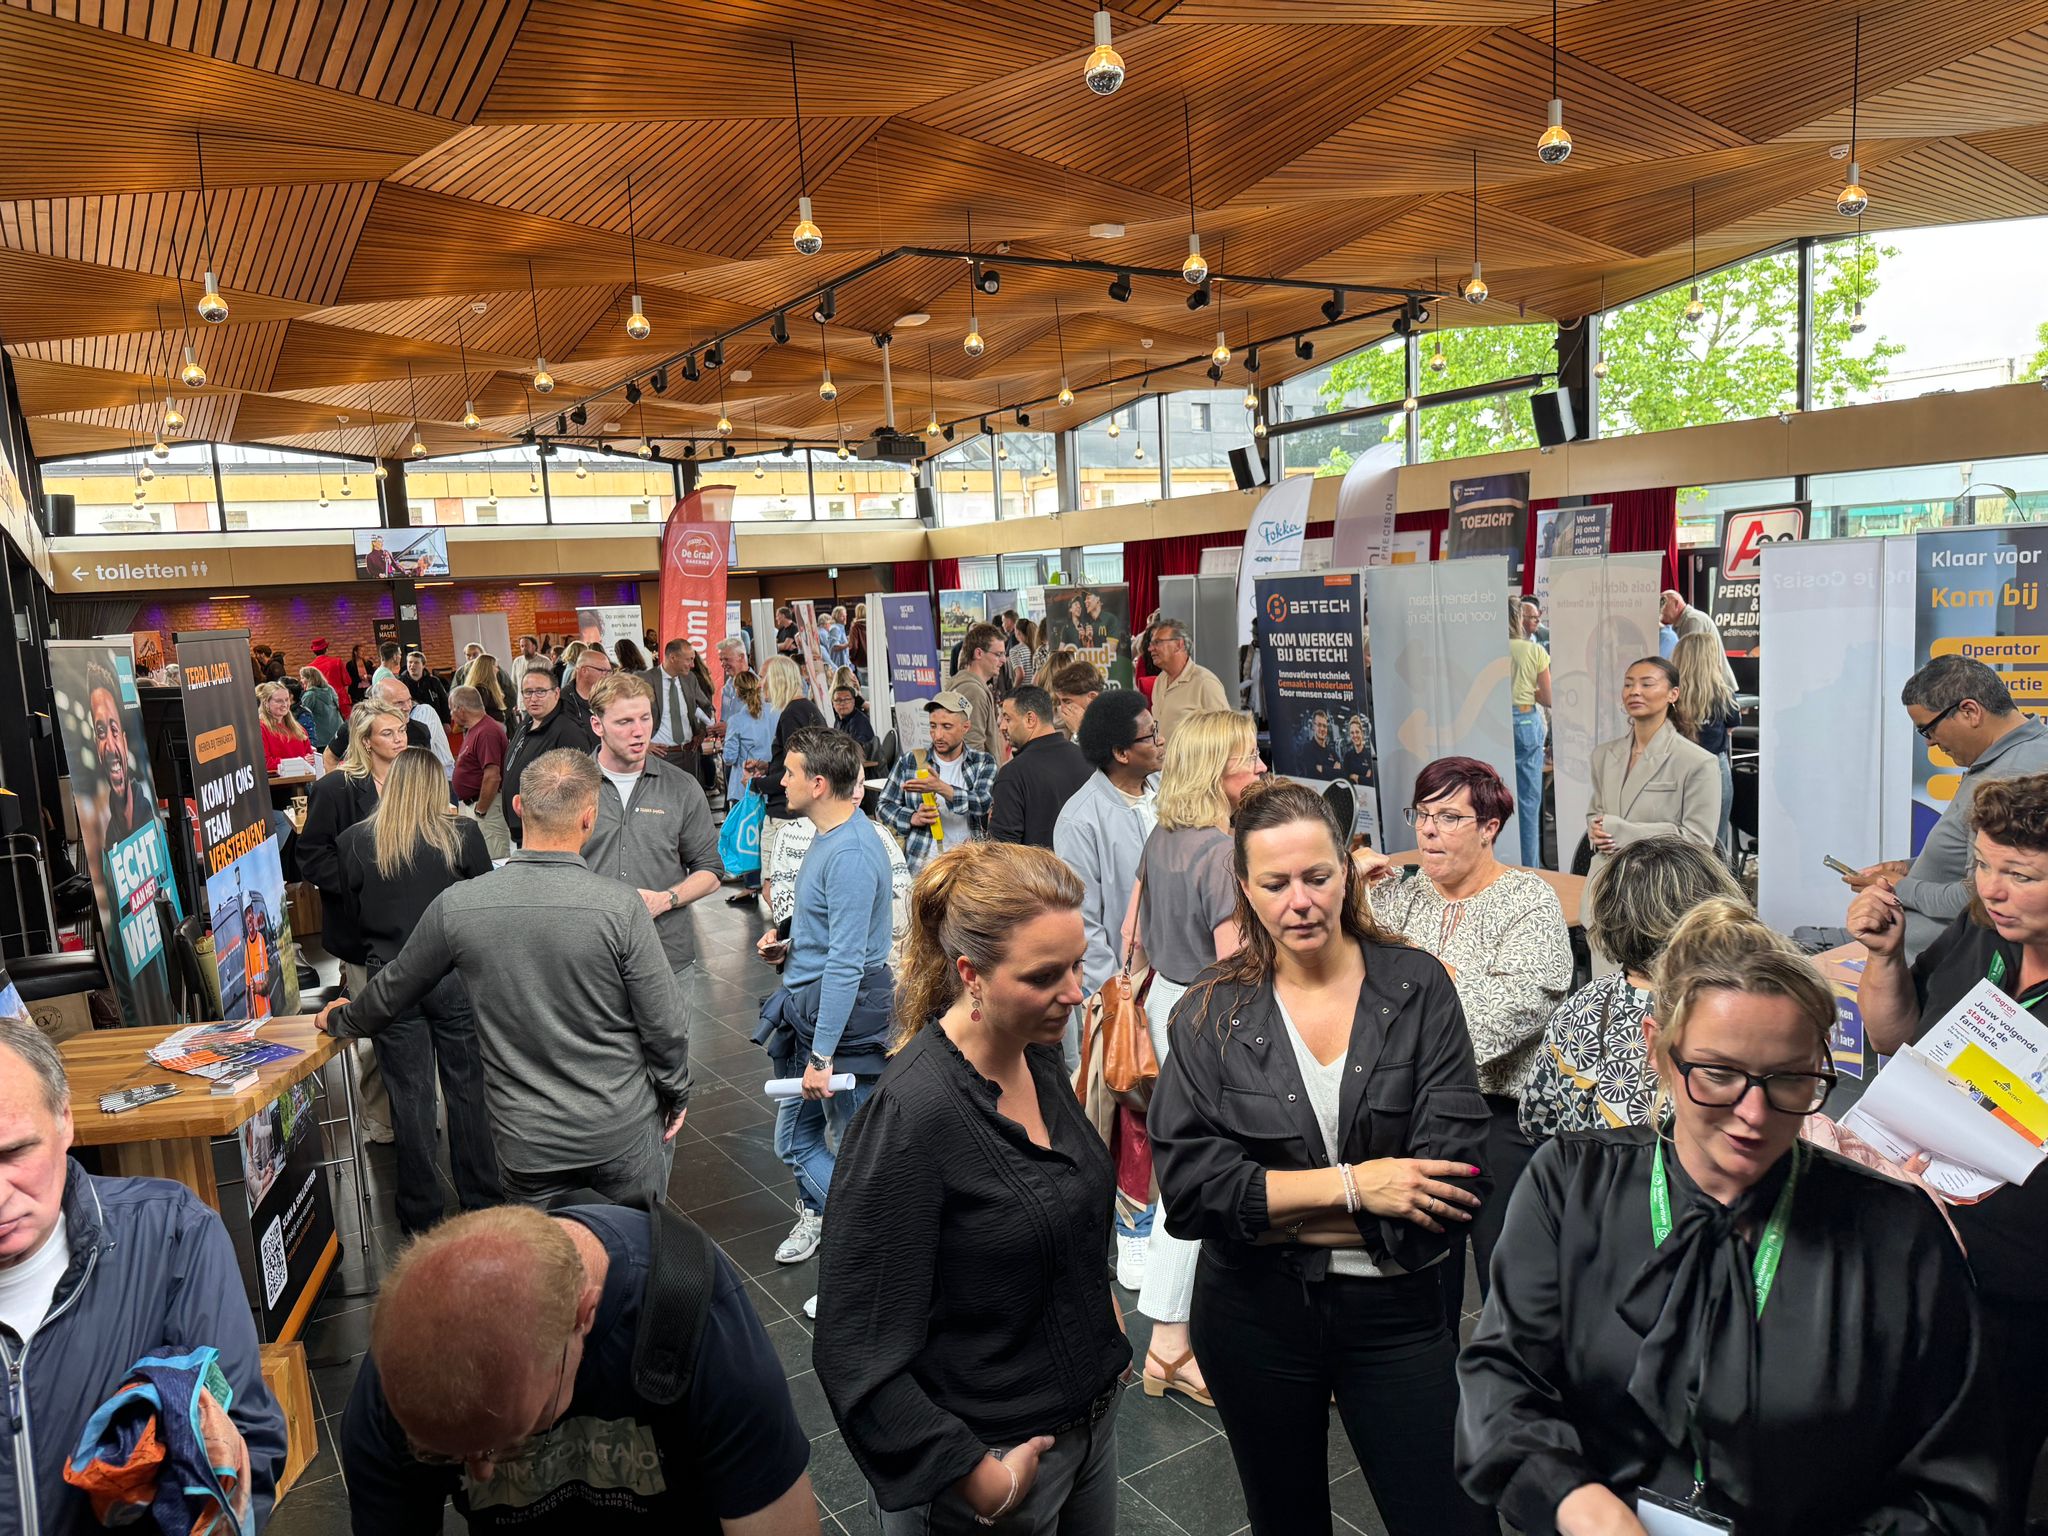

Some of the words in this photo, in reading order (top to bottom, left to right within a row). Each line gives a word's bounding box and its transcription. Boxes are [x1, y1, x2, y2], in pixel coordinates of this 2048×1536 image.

[1381, 493, 1394, 560] PRECISION
[1460, 513, 1514, 529] TOEZICHT
[1576, 514, 1596, 524] Word
[1258, 520, 1302, 546] Fokker
[1575, 525, 1583, 536] jij
[1583, 526, 1600, 534] onze
[1574, 535, 1600, 544] nieuwe
[681, 549, 692, 559] De
[694, 549, 713, 560] Graaf
[1574, 545, 1602, 556] collega?
[1932, 551, 1988, 568] Klaar
[1993, 550, 2042, 565] voor
[95, 563, 187, 581] toiletten
[1932, 587, 1994, 608] Kom
[2003, 582, 2038, 610] bij
[1290, 600, 1350, 613] BETECH
[1751, 598, 1759, 611] &
[1269, 633, 1297, 647] KOM
[1298, 632, 1353, 647] WERKEN
[1277, 648, 1293, 662] BIJ
[1295, 648, 1348, 662] BETECH!
[1962, 643, 2041, 658] Operator
[896, 654, 910, 667] VIND
[911, 654, 928, 667] JOUW
[894, 669, 916, 682] NIEUWE
[916, 669, 936, 683] BAAN!
[1278, 670, 1318, 679] Innovatieve
[1319, 671, 1351, 680] techniek
[1278, 680, 1307, 689] Gemaakt
[1308, 680, 1315, 689] in
[1315, 681, 1354, 690] Nederland
[1279, 688, 1295, 697] Door
[1296, 690, 1322, 698] mensen
[1323, 689, 1343, 699] zoals
[201, 778, 225, 812] KOM
[235, 764, 254, 796] ONS
[205, 809, 232, 846] TEAM
[209, 818, 266, 874] VERSTERKEN?
[111, 828, 159, 899] ÉCHT
[131, 888, 145, 912] AAN
[1991, 993, 2017, 1015] Fagron
[1959, 1015, 1998, 1050] farmacie.
[1966, 1008, 1986, 1025] stap
[1986, 1022, 1996, 1033] in
[1996, 1031, 2008, 1043] de
[1974, 1001, 1999, 1021] Jouw
[2000, 1020, 2038, 1054] volgende
[282, 1207, 294, 1230] SCAN
